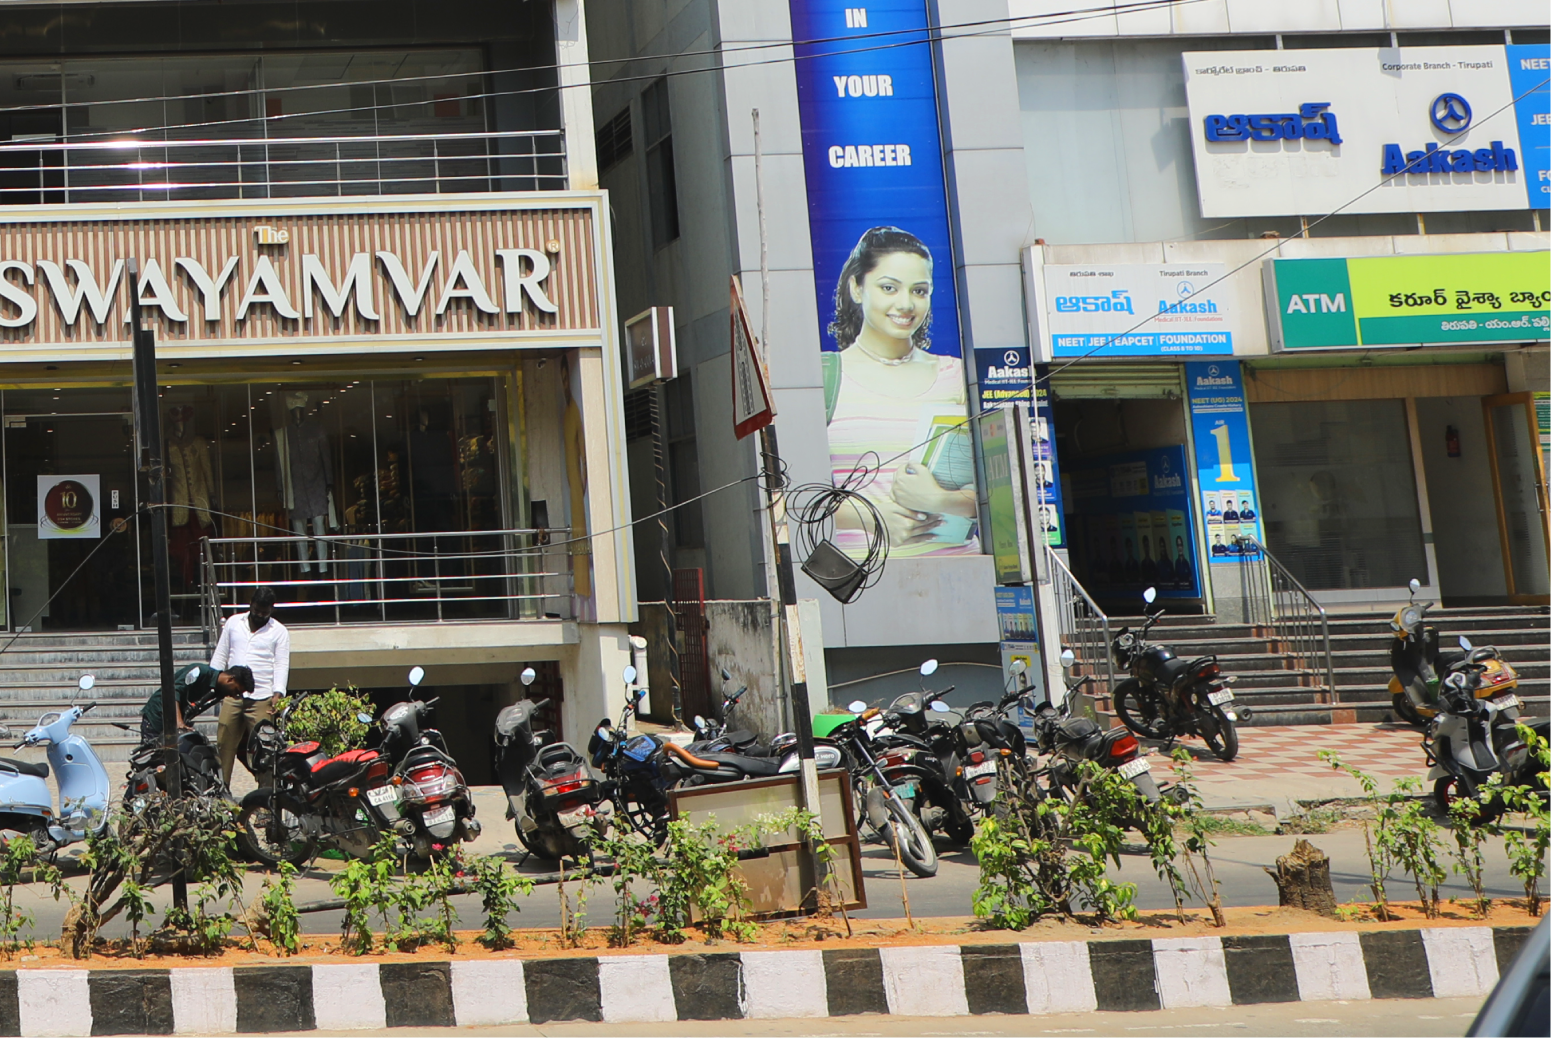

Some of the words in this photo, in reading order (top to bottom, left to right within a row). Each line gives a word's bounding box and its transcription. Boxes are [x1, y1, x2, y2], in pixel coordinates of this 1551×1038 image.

[845, 7, 868, 28] IN
[1382, 62, 1422, 72] Corporate
[1424, 61, 1450, 70] Branch
[1458, 60, 1494, 72] Tirupati
[833, 74, 894, 98] YOUR
[1203, 101, 1343, 146] ఆకాష్
[828, 144, 912, 168] CAREER
[1381, 140, 1519, 176] Aakash
[253, 224, 290, 245] The
[1159, 270, 1185, 278] Tirupati
[1055, 289, 1135, 315] ఆకాష్
[1157, 299, 1218, 314] Aakash
[1286, 292, 1347, 314] ATM
[1389, 288, 1448, 308] కరూర్
[1455, 290, 1502, 310] వైశ్యా
[1058, 338, 1084, 347] NEET
[1114, 336, 1154, 346] EAPCET
[1160, 334, 1227, 344] FOUNDATION
[1196, 376, 1233, 386] Aakash
[1210, 424, 1240, 482] 1
